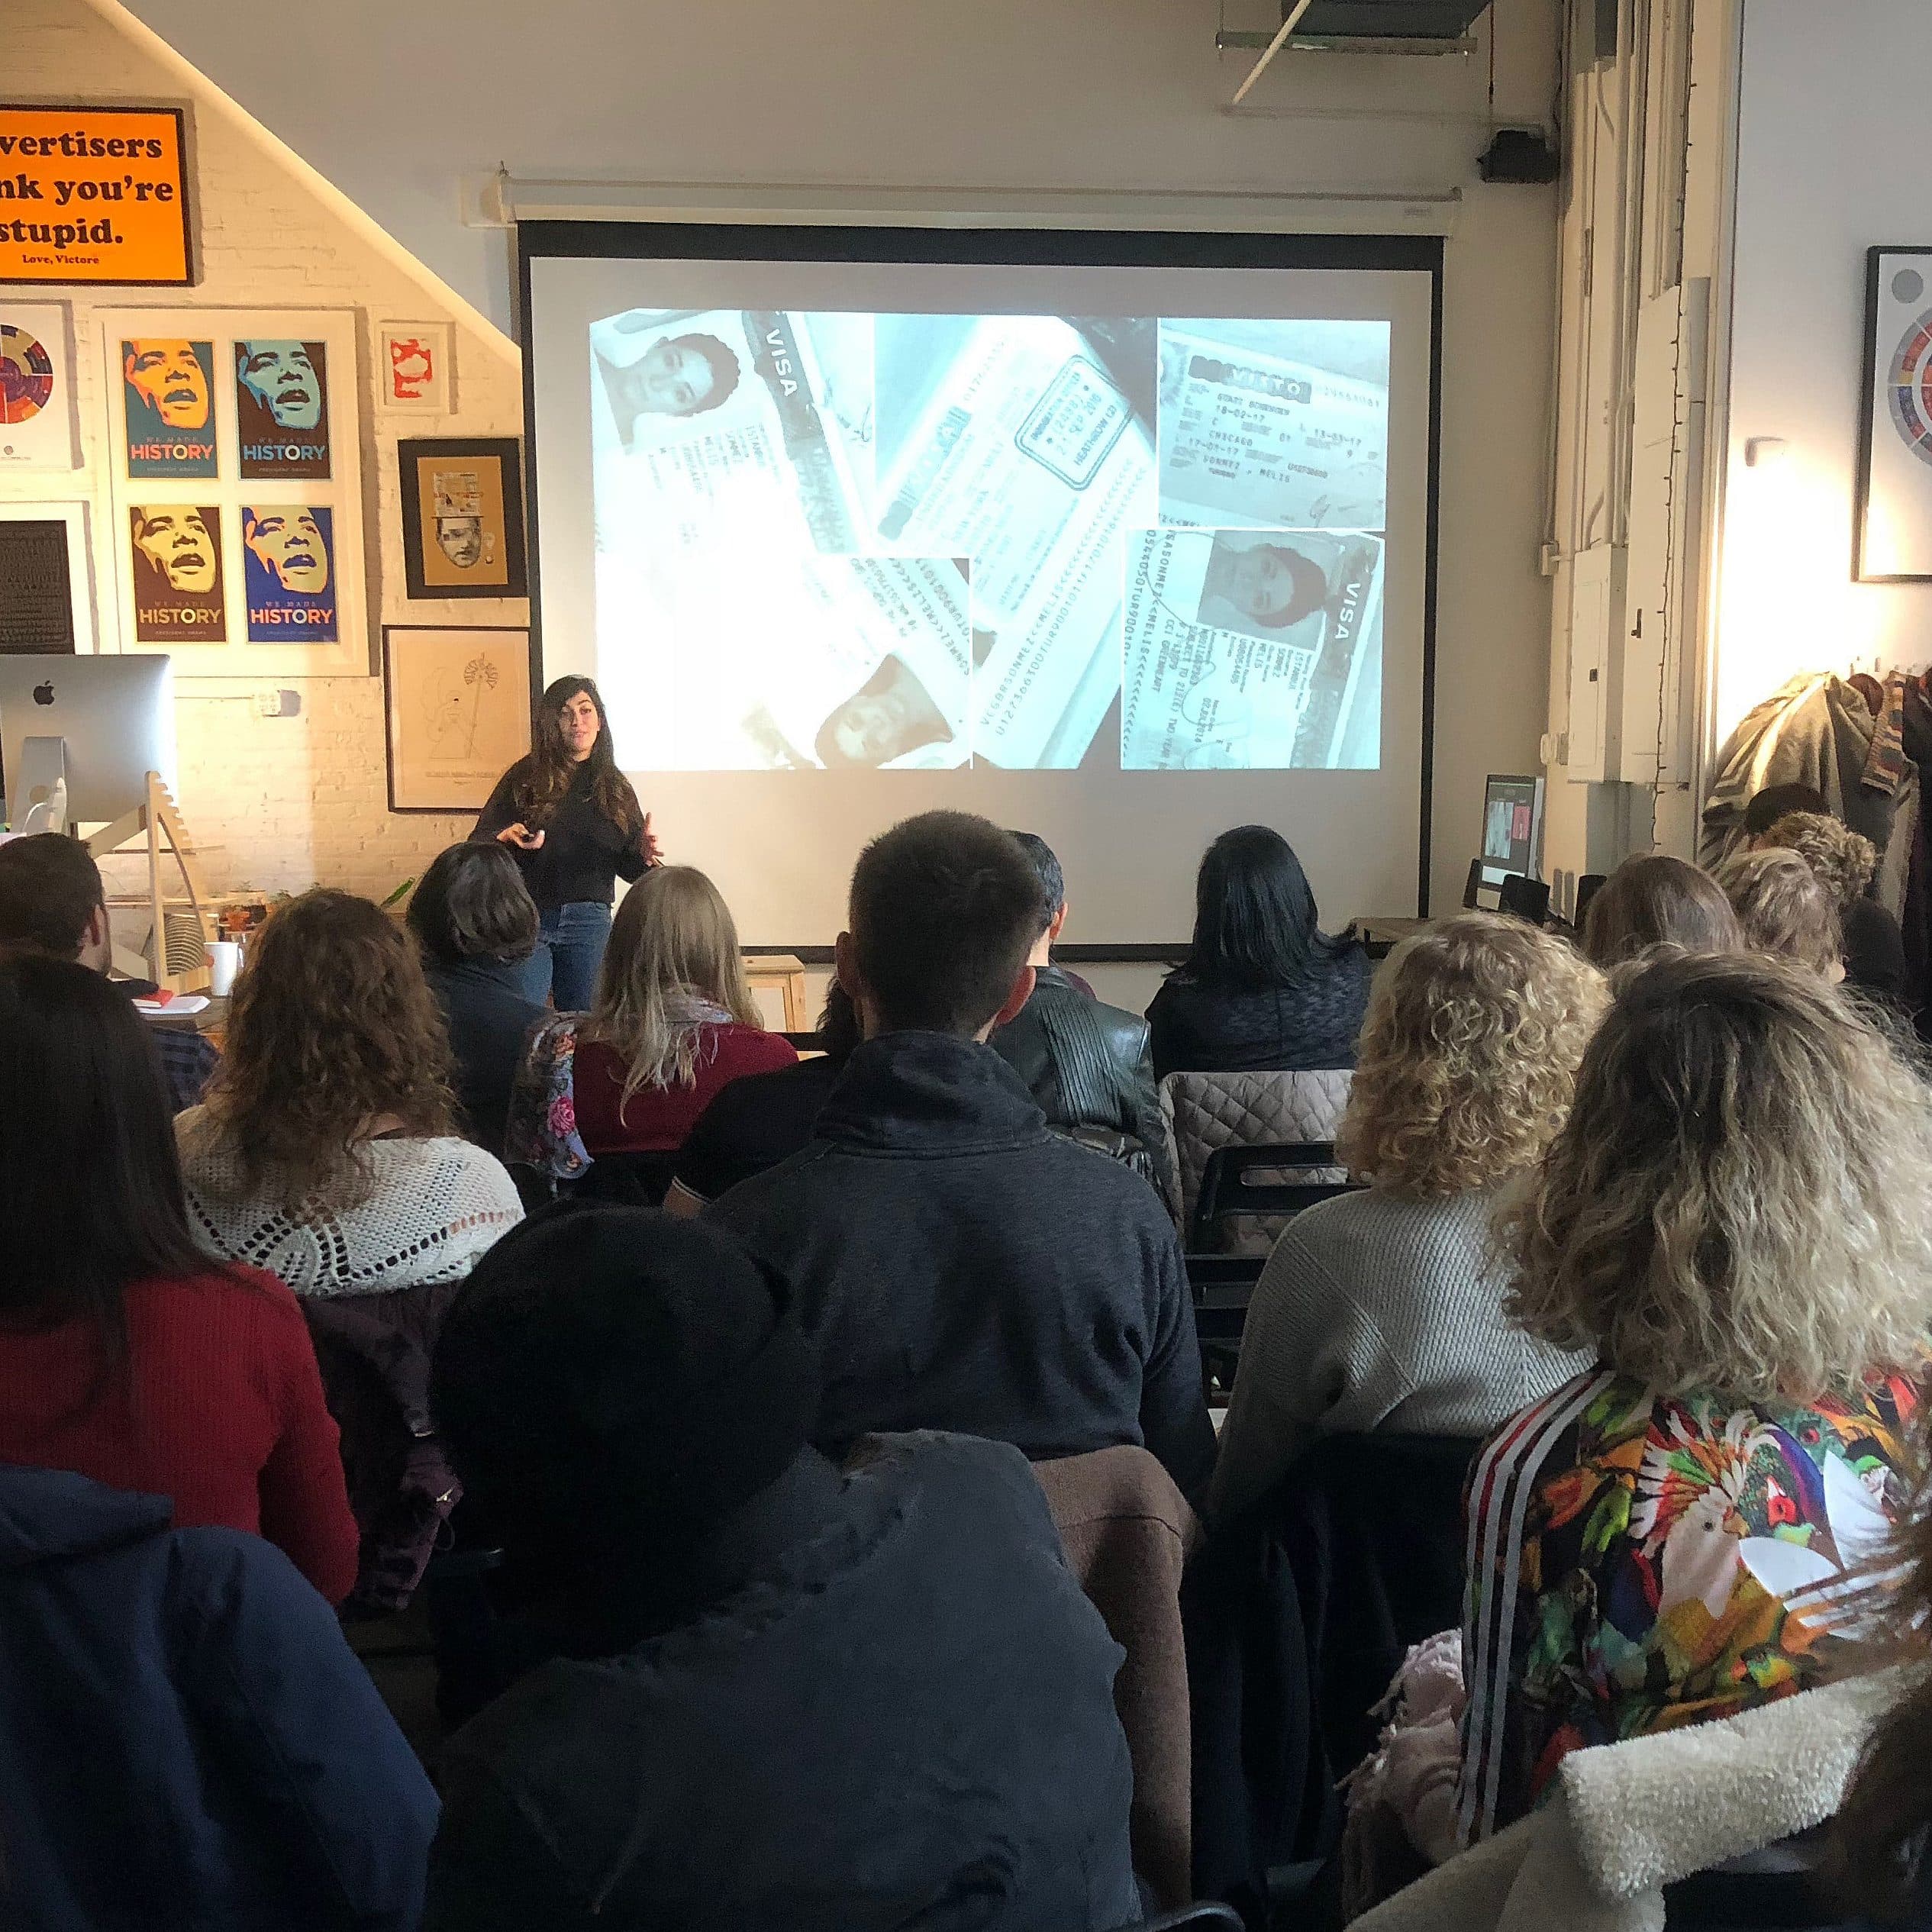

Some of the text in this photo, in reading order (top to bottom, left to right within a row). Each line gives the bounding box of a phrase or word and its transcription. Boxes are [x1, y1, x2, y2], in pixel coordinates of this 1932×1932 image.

[54, 176, 174, 206] you're
[22, 254, 99, 265] Love, Victore
[766, 328, 798, 397] VISA
[1070, 416, 1110, 466] HEATHROW
[1208, 429, 1253, 447] CHICAGO
[131, 443, 214, 460] HISTORY
[243, 444, 325, 461] HISTORY
[139, 608, 221, 624] HISTORY
[250, 608, 333, 624] HISTORY
[1335, 582, 1362, 640] VISA
